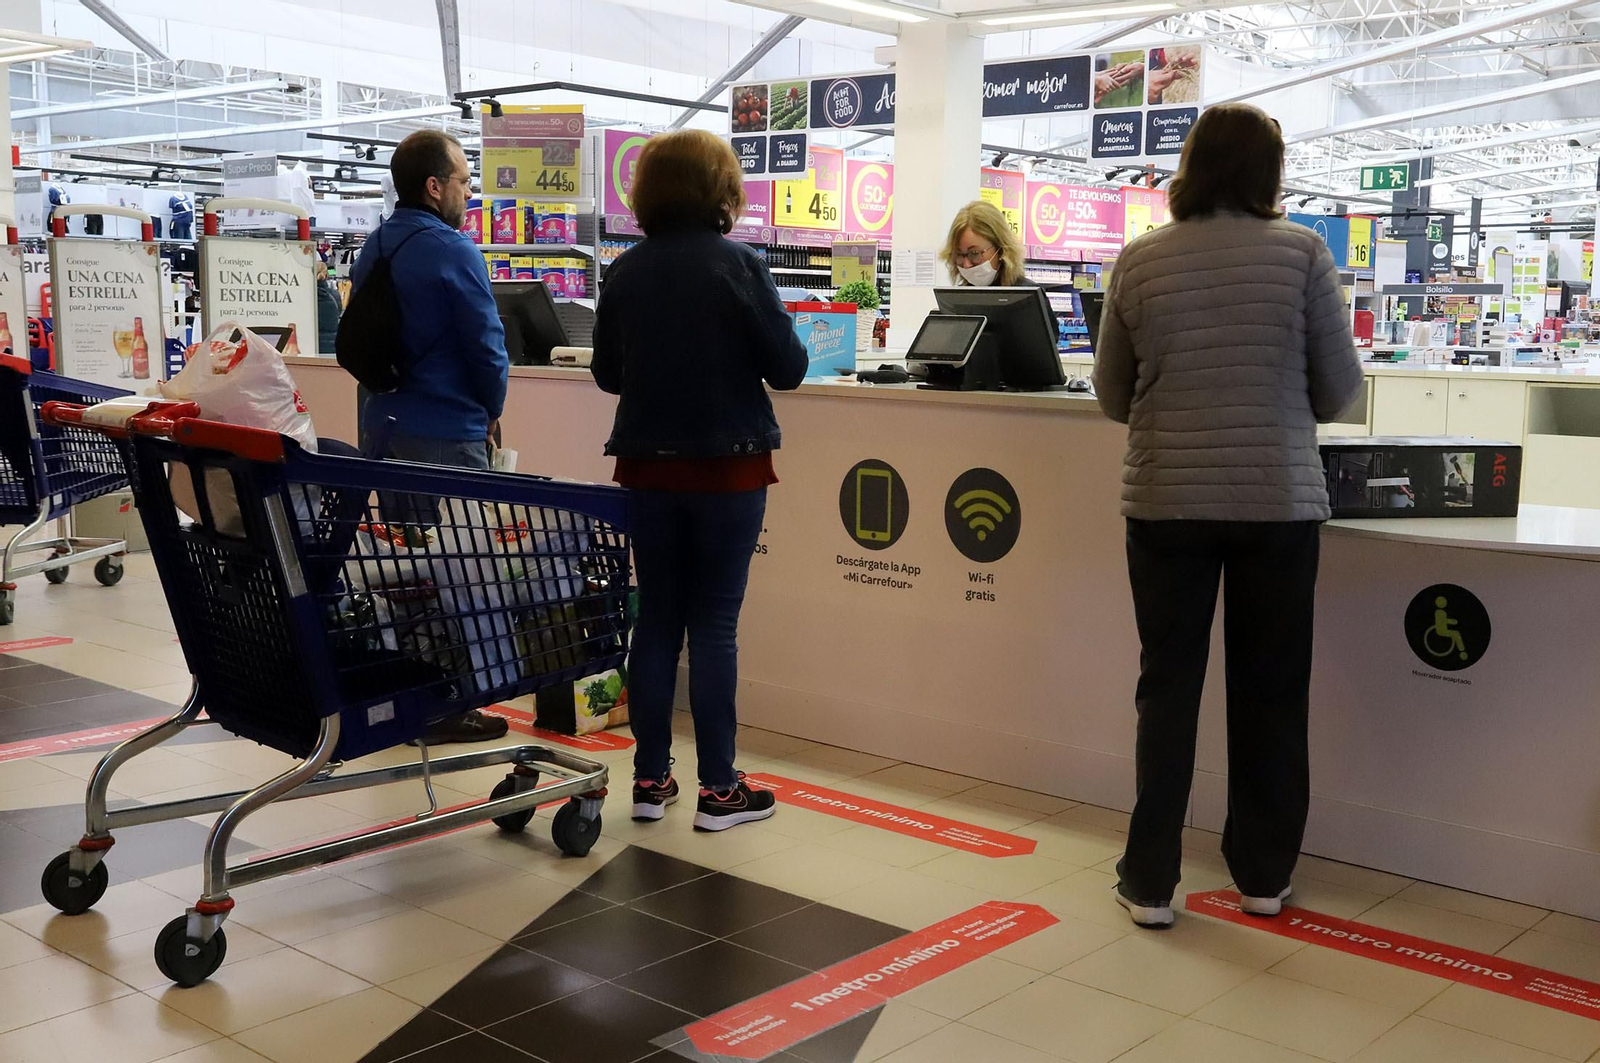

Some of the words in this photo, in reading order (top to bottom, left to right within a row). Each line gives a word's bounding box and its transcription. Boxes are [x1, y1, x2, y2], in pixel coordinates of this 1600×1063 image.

[1026, 72, 1068, 104] mejor
[836, 97, 850, 110] FOR
[1054, 102, 1084, 110] carrefour.es
[834, 106, 854, 120] FOOD
[1101, 120, 1134, 134] Marcas
[228, 164, 248, 175] Super
[249, 161, 272, 172] Precio
[741, 159, 756, 168] BIO
[536, 170, 562, 191] 44
[562, 181, 574, 192] 50
[1069, 189, 1077, 199] TE
[1078, 190, 1122, 204] DEVOLVEMOS
[808, 193, 822, 219] 4
[823, 207, 837, 221] 50
[1068, 202, 1075, 211] EL
[1075, 202, 1097, 220] 50%
[1355, 244, 1366, 262] 16
[66, 257, 99, 266] Consigue
[218, 257, 253, 267] Consigue
[68, 270, 100, 283] UNA
[104, 271, 144, 284] CENA
[220, 271, 253, 284] UNA
[257, 272, 299, 286] CENA
[69, 286, 138, 299] ESTRELLA
[220, 288, 292, 303] ESTRELLA
[220, 309, 237, 317] para
[806, 324, 845, 346] Almond
[814, 338, 841, 354] Breeze
[1492, 452, 1507, 487] AEG
[836, 555, 889, 571] Descárgate
[891, 561, 899, 572] la
[901, 563, 921, 577] App
[860, 574, 913, 589] Carrefour»
[968, 572, 994, 584] Wi-fi
[966, 590, 996, 602] gratis
[1412, 670, 1442, 680] Mostrador
[67, 728, 134, 744] metro
[801, 794, 860, 811] metro
[859, 805, 934, 830] mínimo
[964, 919, 984, 929] favor
[995, 910, 1026, 923] distancia
[984, 921, 1017, 937] seguridad
[1302, 923, 1391, 949] metro
[1396, 946, 1513, 981] mínimo
[790, 1002, 813, 1011] 1
[808, 973, 883, 1006] metro
[878, 938, 961, 975] mínimo
[1556, 983, 1589, 994] favor
[729, 1015, 774, 1036] seguridad
[759, 1019, 787, 1032] todos
